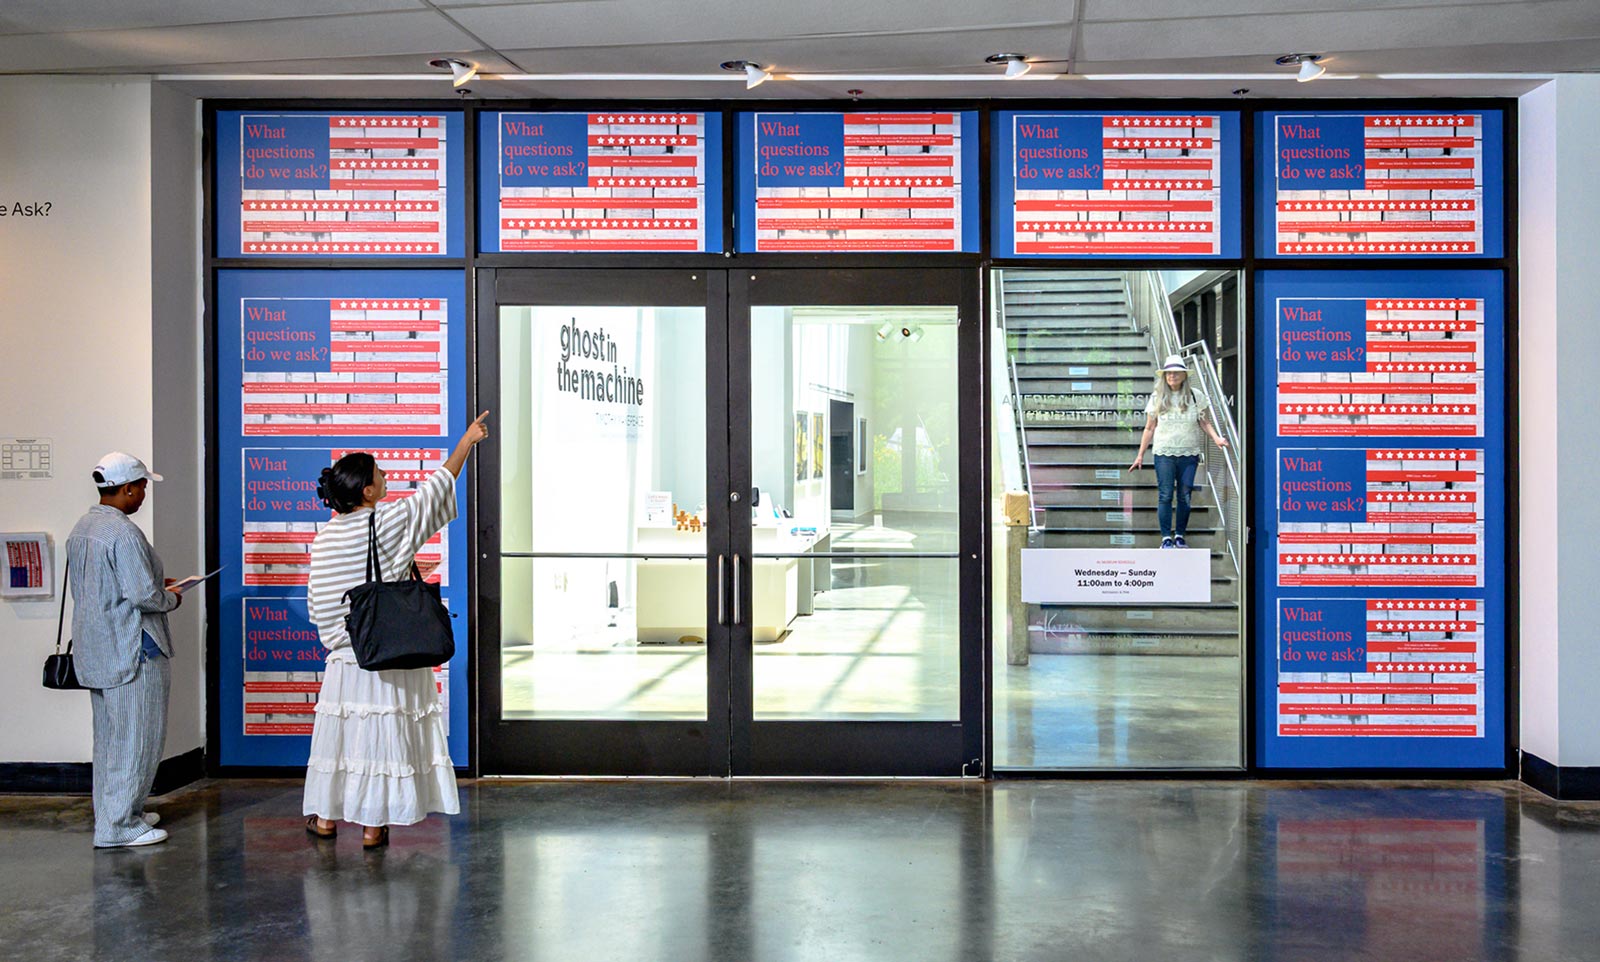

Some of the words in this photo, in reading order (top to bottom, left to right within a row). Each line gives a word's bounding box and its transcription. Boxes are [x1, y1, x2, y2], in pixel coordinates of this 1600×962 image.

[247, 125, 285, 138] What
[505, 123, 543, 136] What
[761, 123, 799, 136] What
[1020, 125, 1058, 138] What
[1282, 125, 1320, 138] What
[246, 144, 315, 162] questions
[504, 142, 573, 160] questions
[760, 142, 829, 160] questions
[1019, 144, 1088, 162] questions
[1281, 144, 1350, 162] questions
[246, 164, 264, 178] do
[269, 168, 289, 178] we
[295, 164, 327, 178] ask?
[504, 162, 522, 176] do
[527, 166, 547, 176] we
[553, 162, 585, 176] ask?
[760, 162, 778, 176] do
[783, 166, 803, 176] we
[809, 162, 841, 176] ask?
[1019, 164, 1037, 178] do
[1042, 168, 1062, 178] we
[1068, 164, 1100, 178] ask?
[1281, 164, 1299, 178] do
[1304, 168, 1324, 178] we
[1330, 164, 1362, 178] ask?
[12, 202, 52, 216] Ask?
[248, 308, 286, 321] What
[1283, 308, 1321, 321] What
[247, 327, 316, 345] questions
[560, 317, 605, 362] ghost
[607, 333, 617, 363] in
[1282, 327, 1351, 345] questions
[247, 347, 265, 361] do
[270, 351, 290, 361] we
[296, 347, 328, 361] ask?
[1282, 347, 1300, 361] do
[1305, 351, 1325, 361] we
[1331, 347, 1363, 361] ask?
[557, 361, 579, 393] the
[580, 365, 643, 406] machine
[249, 457, 287, 470] What
[1284, 458, 1322, 471] What
[248, 476, 317, 494] questions
[1283, 477, 1352, 495] questions
[248, 496, 266, 510] do
[271, 500, 291, 510] we
[297, 497, 326, 511] ask
[1283, 497, 1301, 511] do
[1306, 501, 1326, 511] we
[1332, 497, 1364, 511] ask?
[1074, 569, 1119, 577] Wednesday
[1128, 569, 1157, 577] Sunday
[1124, 580, 1154, 588] 4:00pm
[250, 607, 288, 620] What
[1284, 608, 1322, 621] What
[249, 626, 318, 644] questions
[1283, 627, 1352, 645] questions
[249, 646, 267, 660] do
[272, 650, 292, 660] we
[1283, 647, 1301, 661] do
[1306, 651, 1326, 661] we
[1332, 647, 1364, 661] ask?
